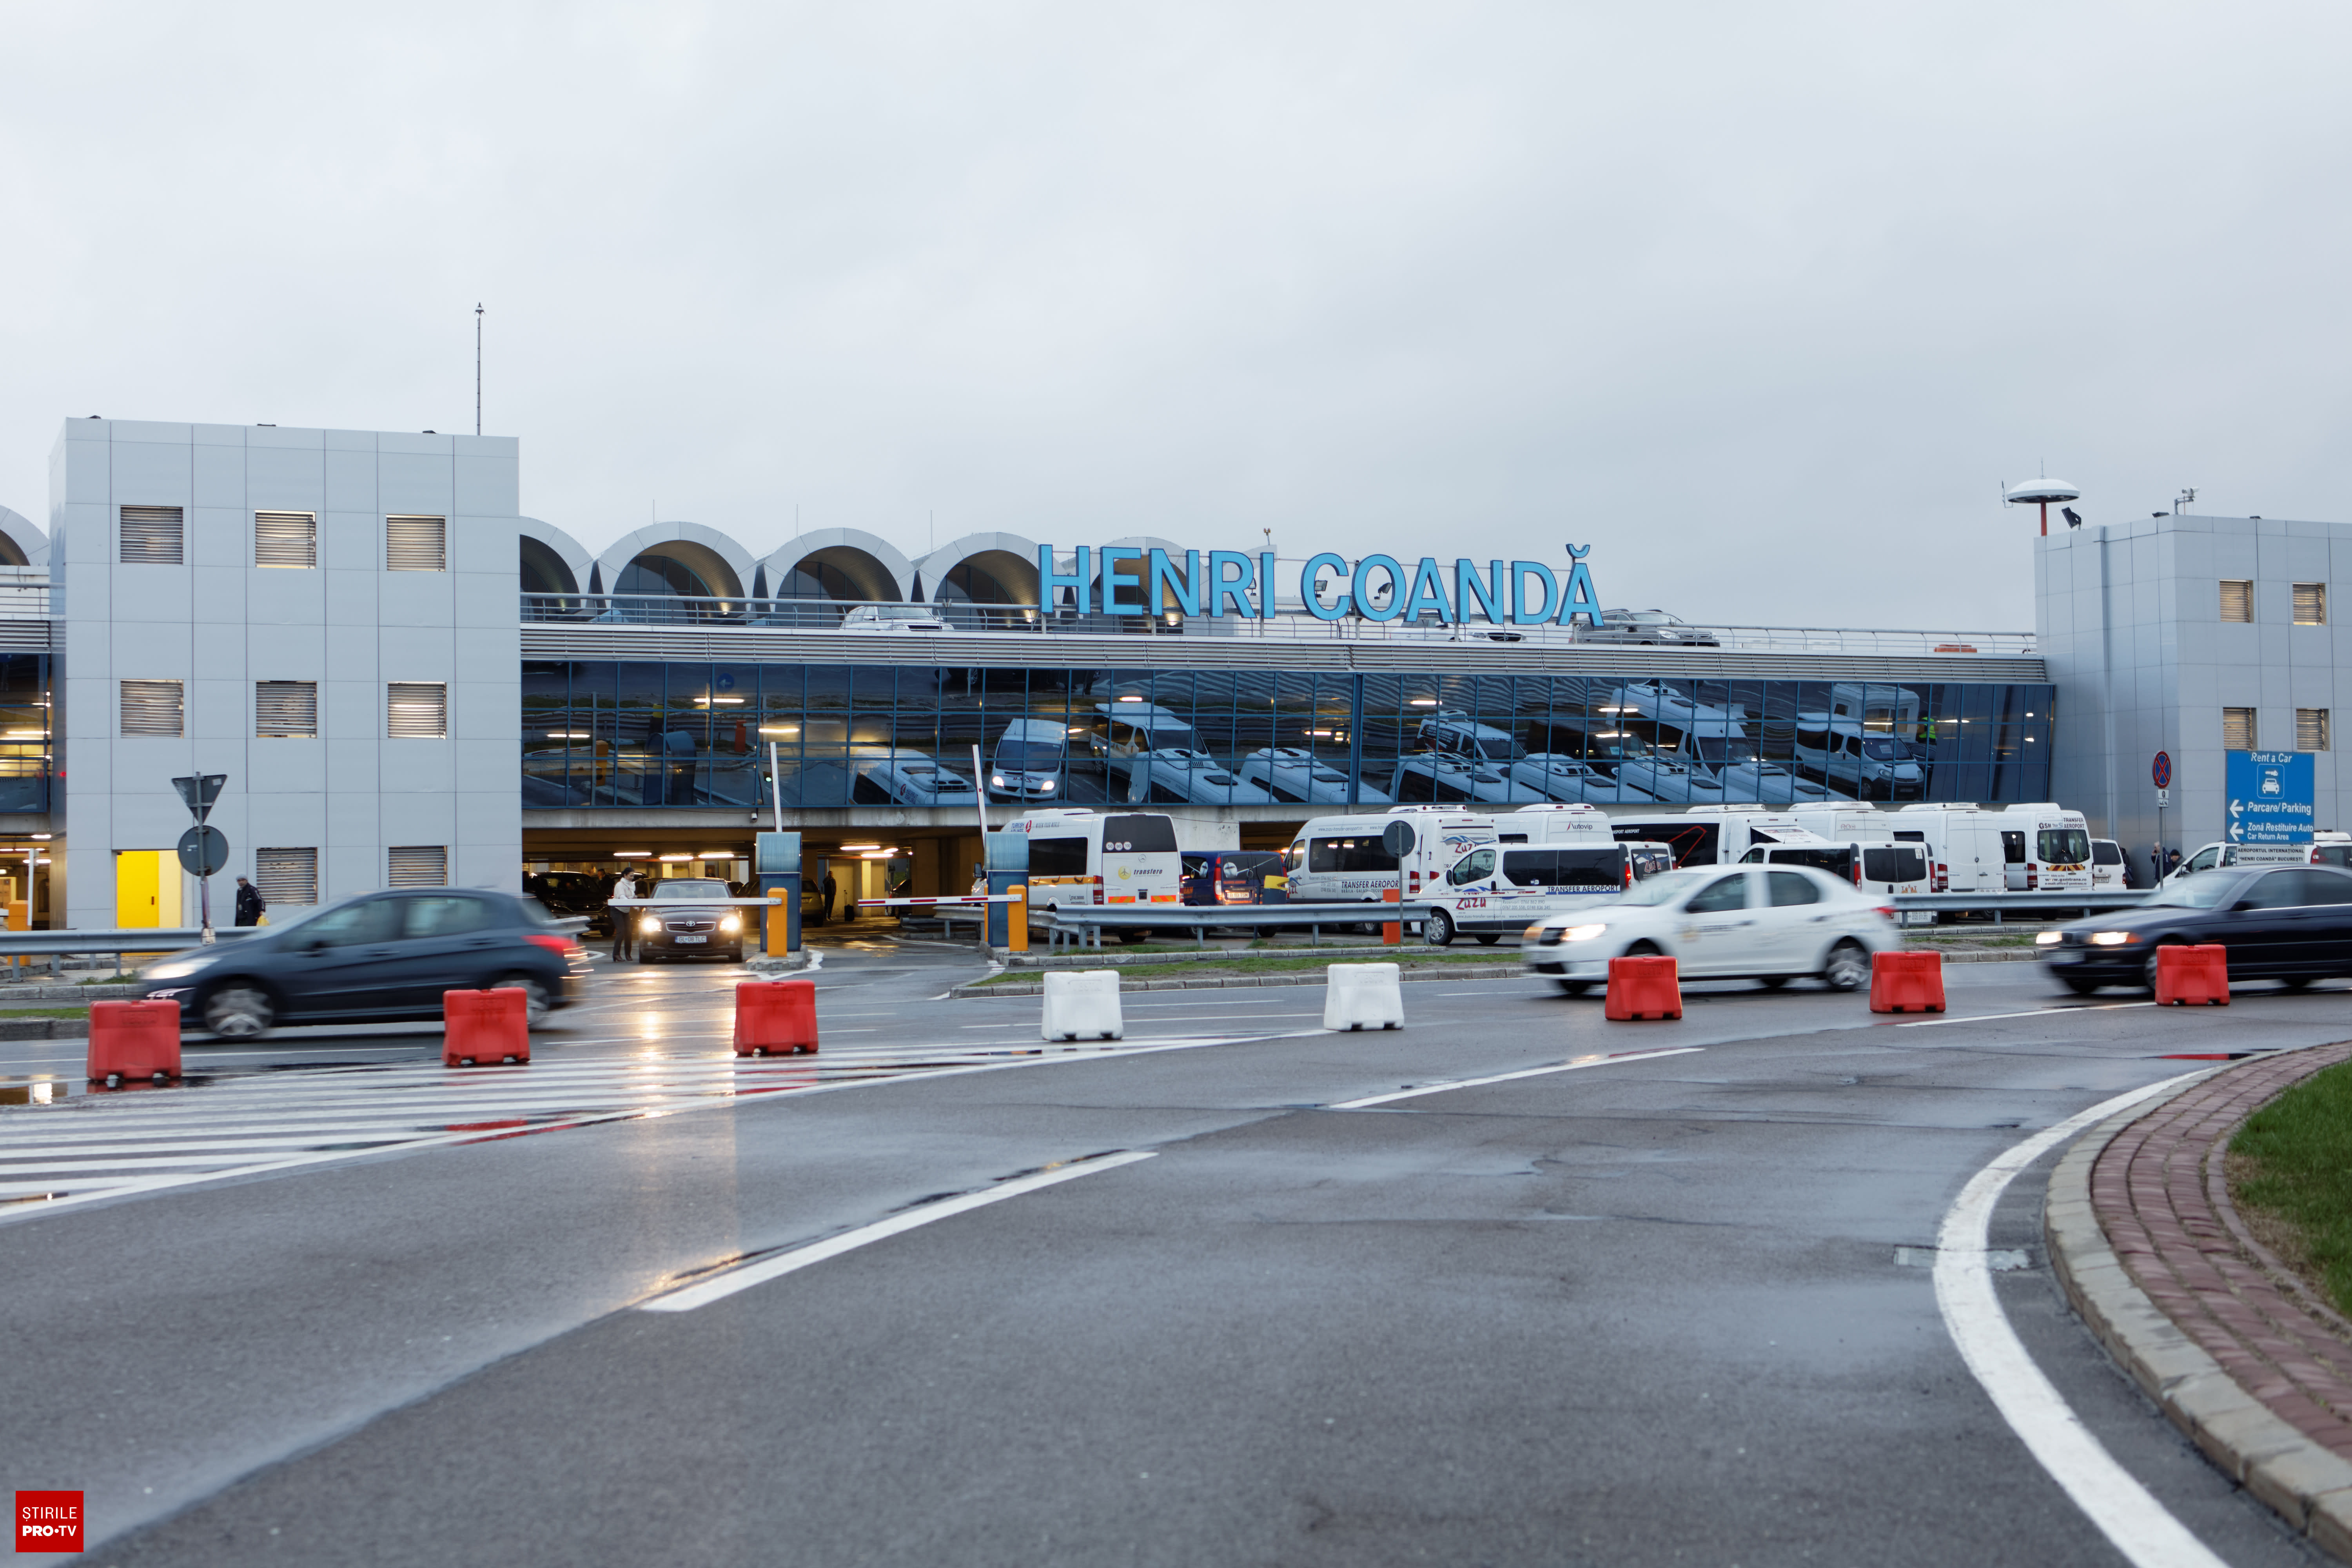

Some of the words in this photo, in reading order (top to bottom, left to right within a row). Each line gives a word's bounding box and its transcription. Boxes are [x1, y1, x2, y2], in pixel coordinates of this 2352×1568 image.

[1038, 544, 1276, 619] HENRI
[1300, 543, 1604, 626] COANDĂ
[2251, 752, 2270, 762] Rent
[2278, 753, 2292, 763] Car
[2247, 802, 2281, 812] Parcare/
[2282, 802, 2311, 816] Parking
[2247, 822, 2264, 831] Zonă
[2266, 822, 2297, 832] Restituire
[2298, 824, 2314, 832] Auto
[1455, 843, 1479, 853] Zuz
